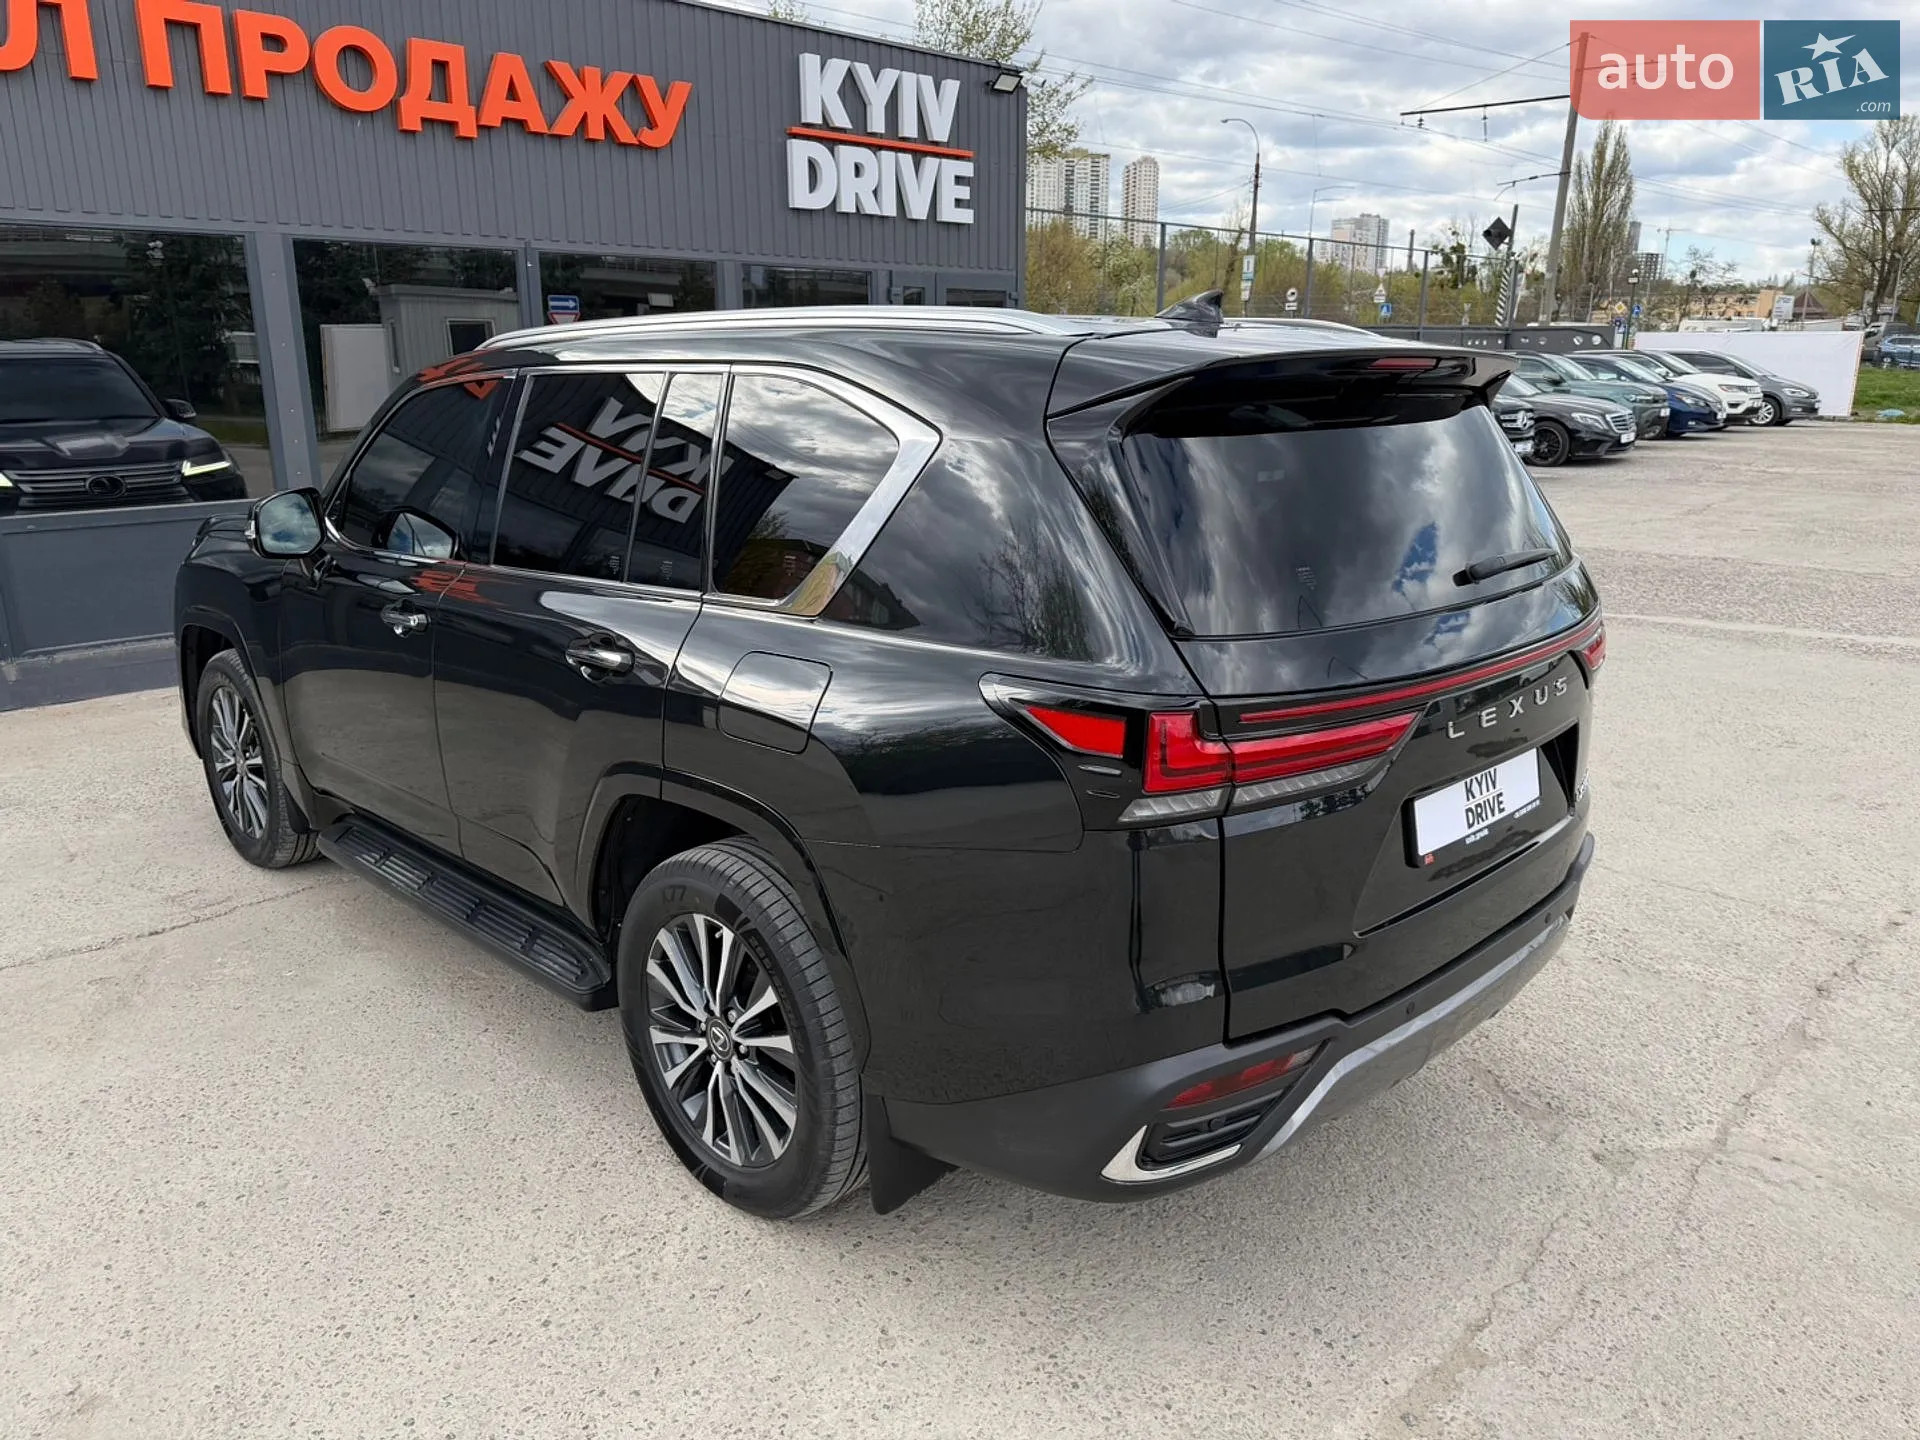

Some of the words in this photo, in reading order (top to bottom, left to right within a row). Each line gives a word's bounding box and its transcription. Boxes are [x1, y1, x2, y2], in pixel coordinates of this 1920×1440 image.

[135, 0, 692, 149] ПРОДАЖУ
[799, 52, 961, 143] KYIV
[786, 138, 975, 224] DRIVE
[1447, 676, 1568, 739] LEXUS
[1463, 768, 1498, 802] KYIV
[1465, 792, 1506, 829] DRIVE
